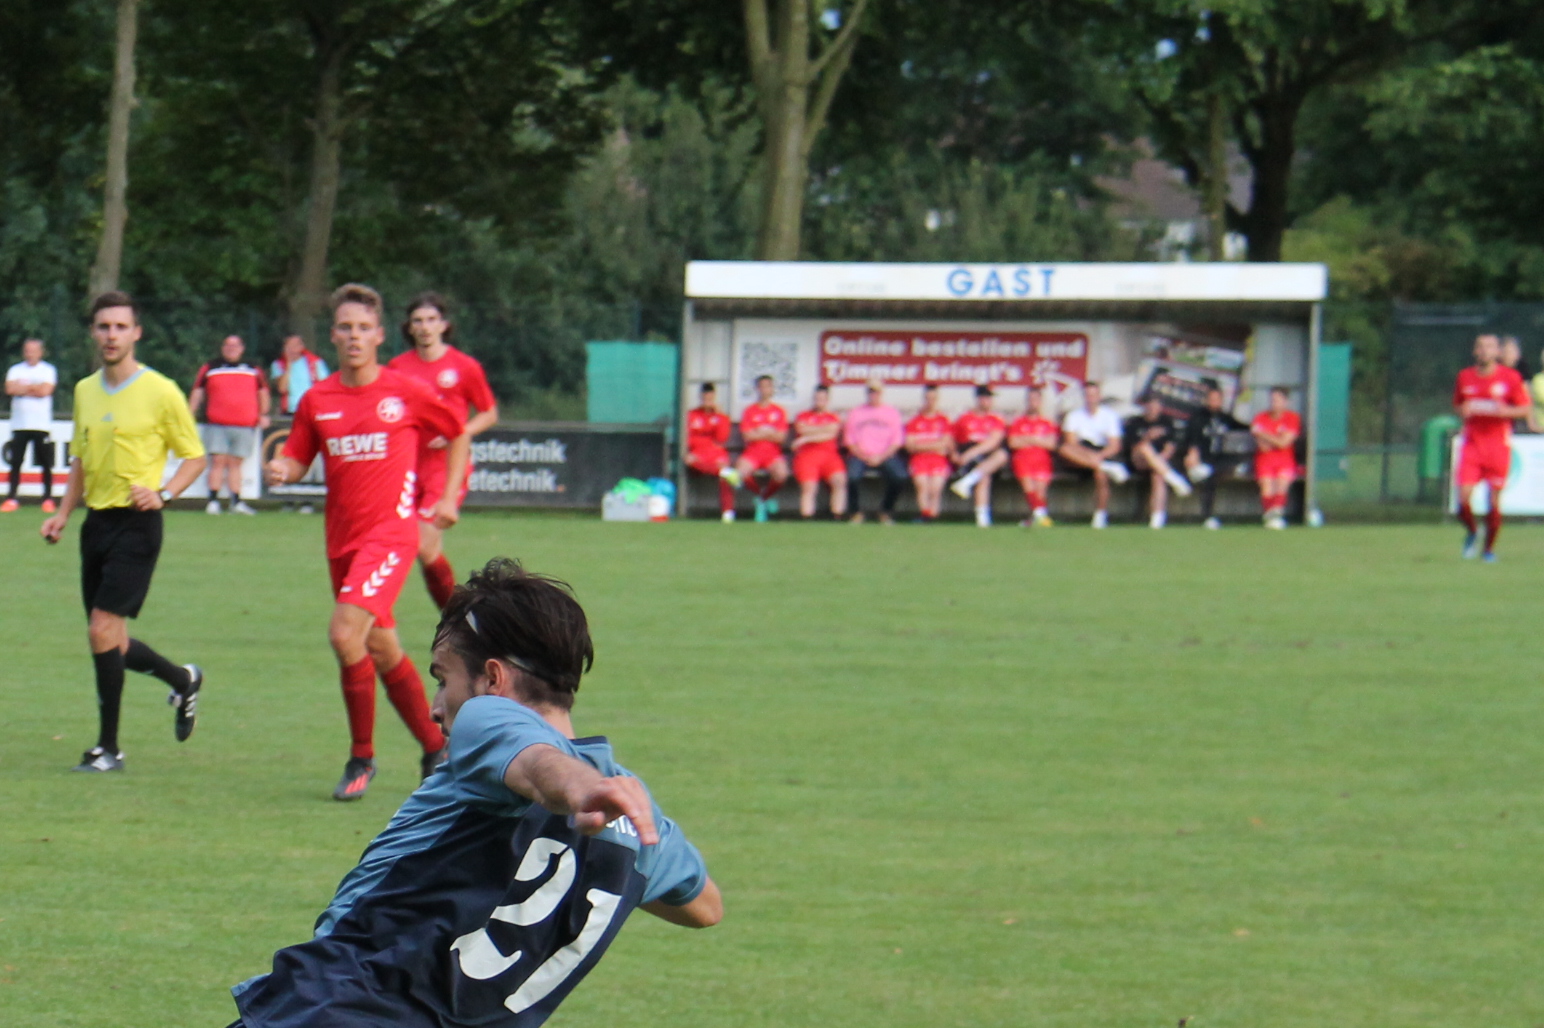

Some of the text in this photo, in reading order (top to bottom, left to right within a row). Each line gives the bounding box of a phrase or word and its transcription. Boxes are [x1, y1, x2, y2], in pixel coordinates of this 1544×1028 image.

[946, 268, 1055, 297] GAST
[823, 335, 1084, 358] Online bestellen und
[326, 432, 389, 457] REWE
[450, 837, 623, 1014] 21
